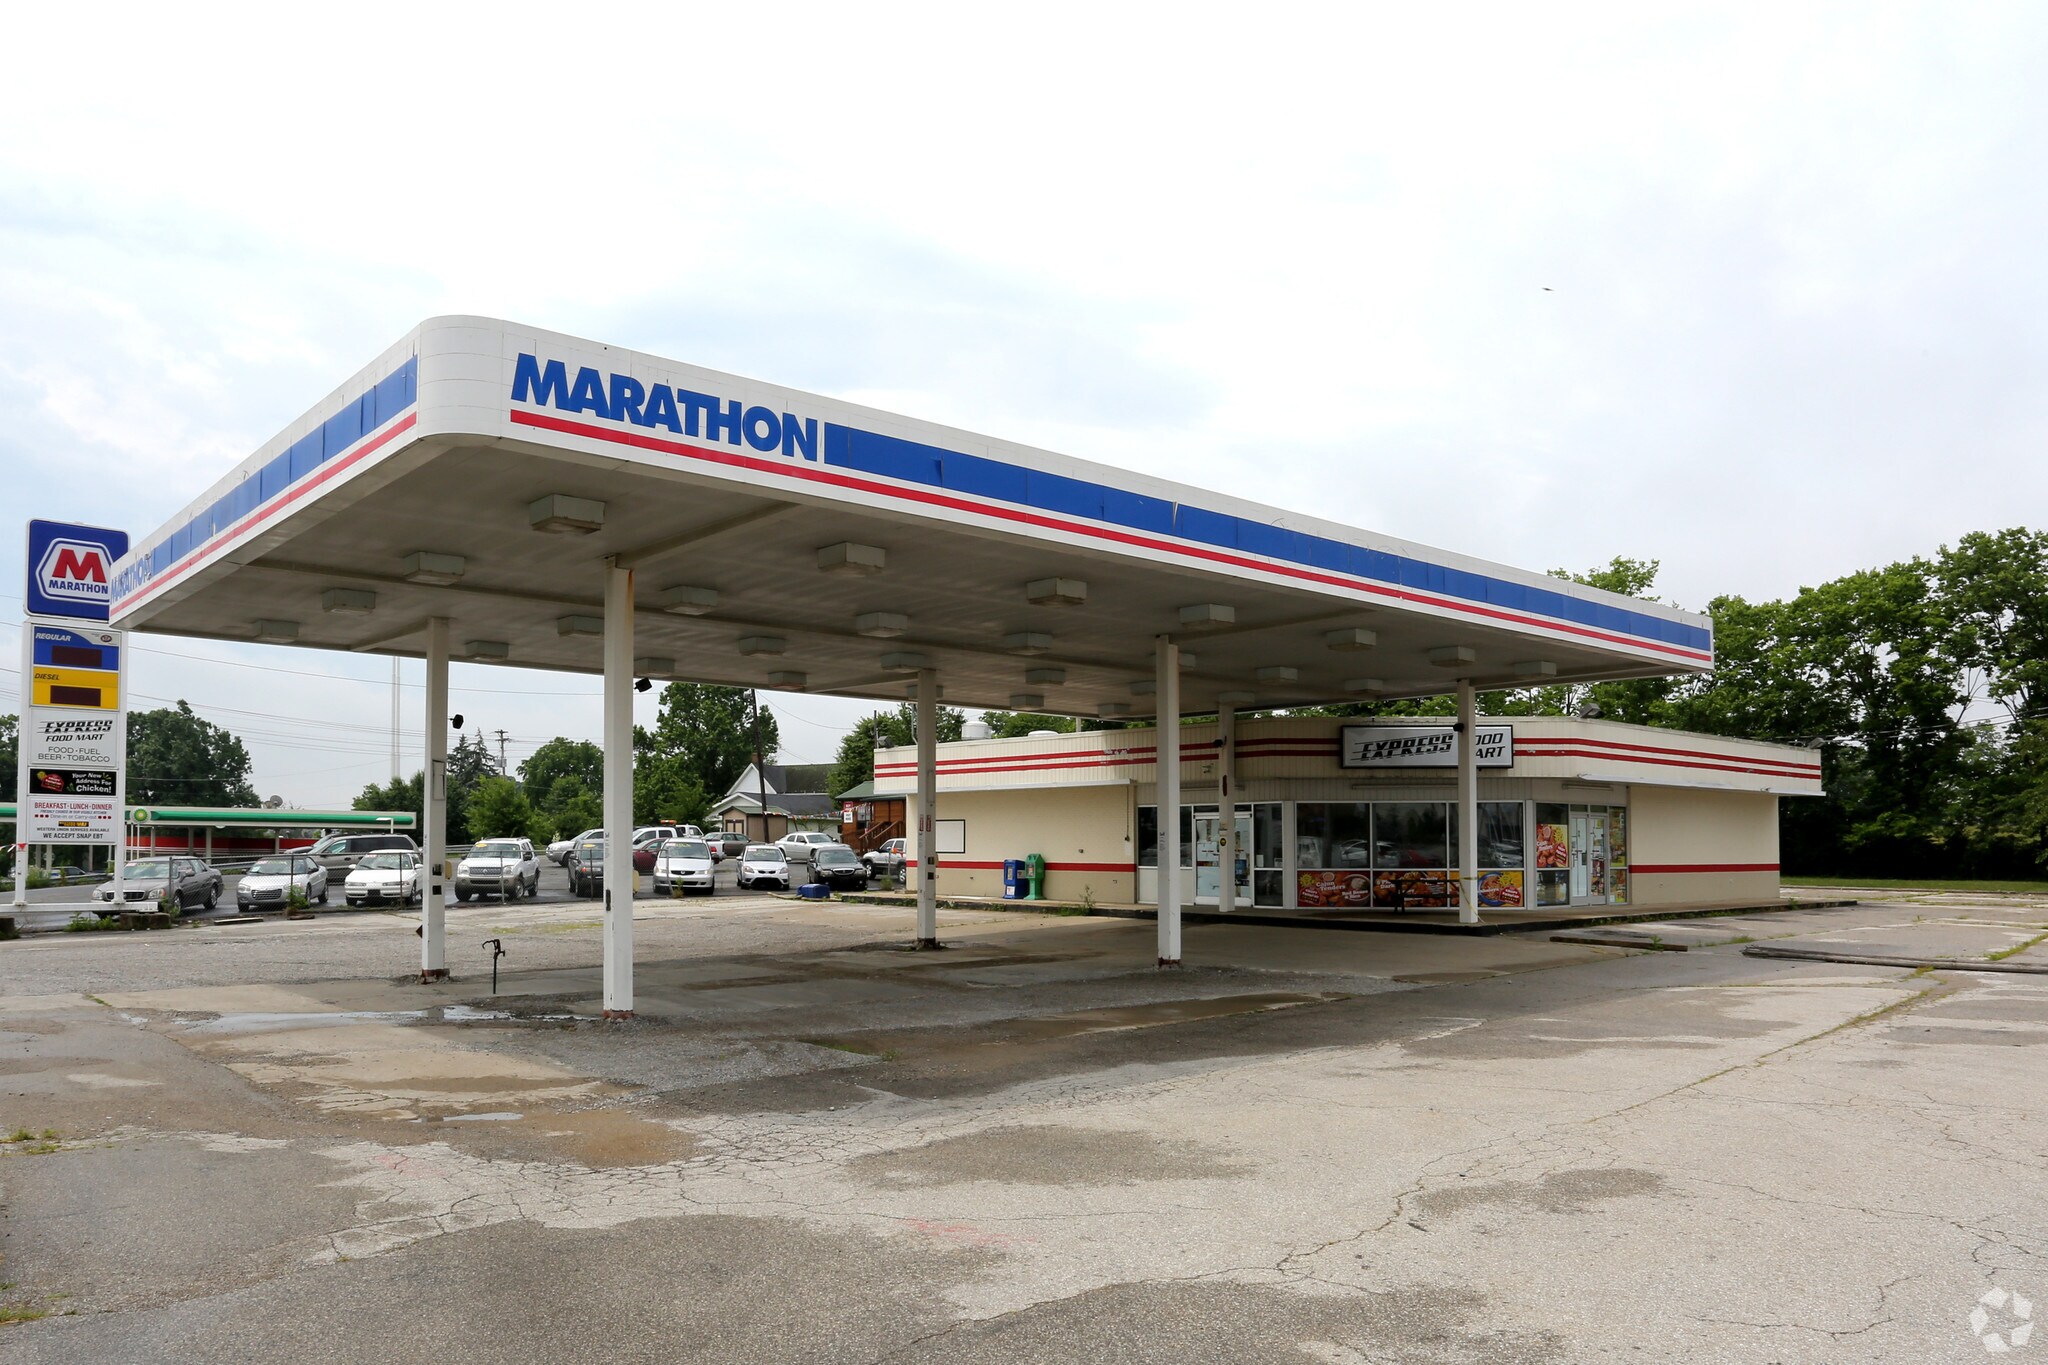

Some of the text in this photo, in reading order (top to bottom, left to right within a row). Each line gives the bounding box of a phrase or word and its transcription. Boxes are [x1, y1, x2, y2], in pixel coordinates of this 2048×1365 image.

[511, 352, 818, 462] MARATHON
[48, 580, 109, 594] MARATHON
[35, 633, 72, 641] REGULAR
[44, 720, 113, 734] EXPRESS
[1475, 733, 1503, 745] OD
[1360, 734, 1454, 760] EXPRESS
[1475, 746, 1506, 758] ART
[76, 785, 112, 793] Chicken!
